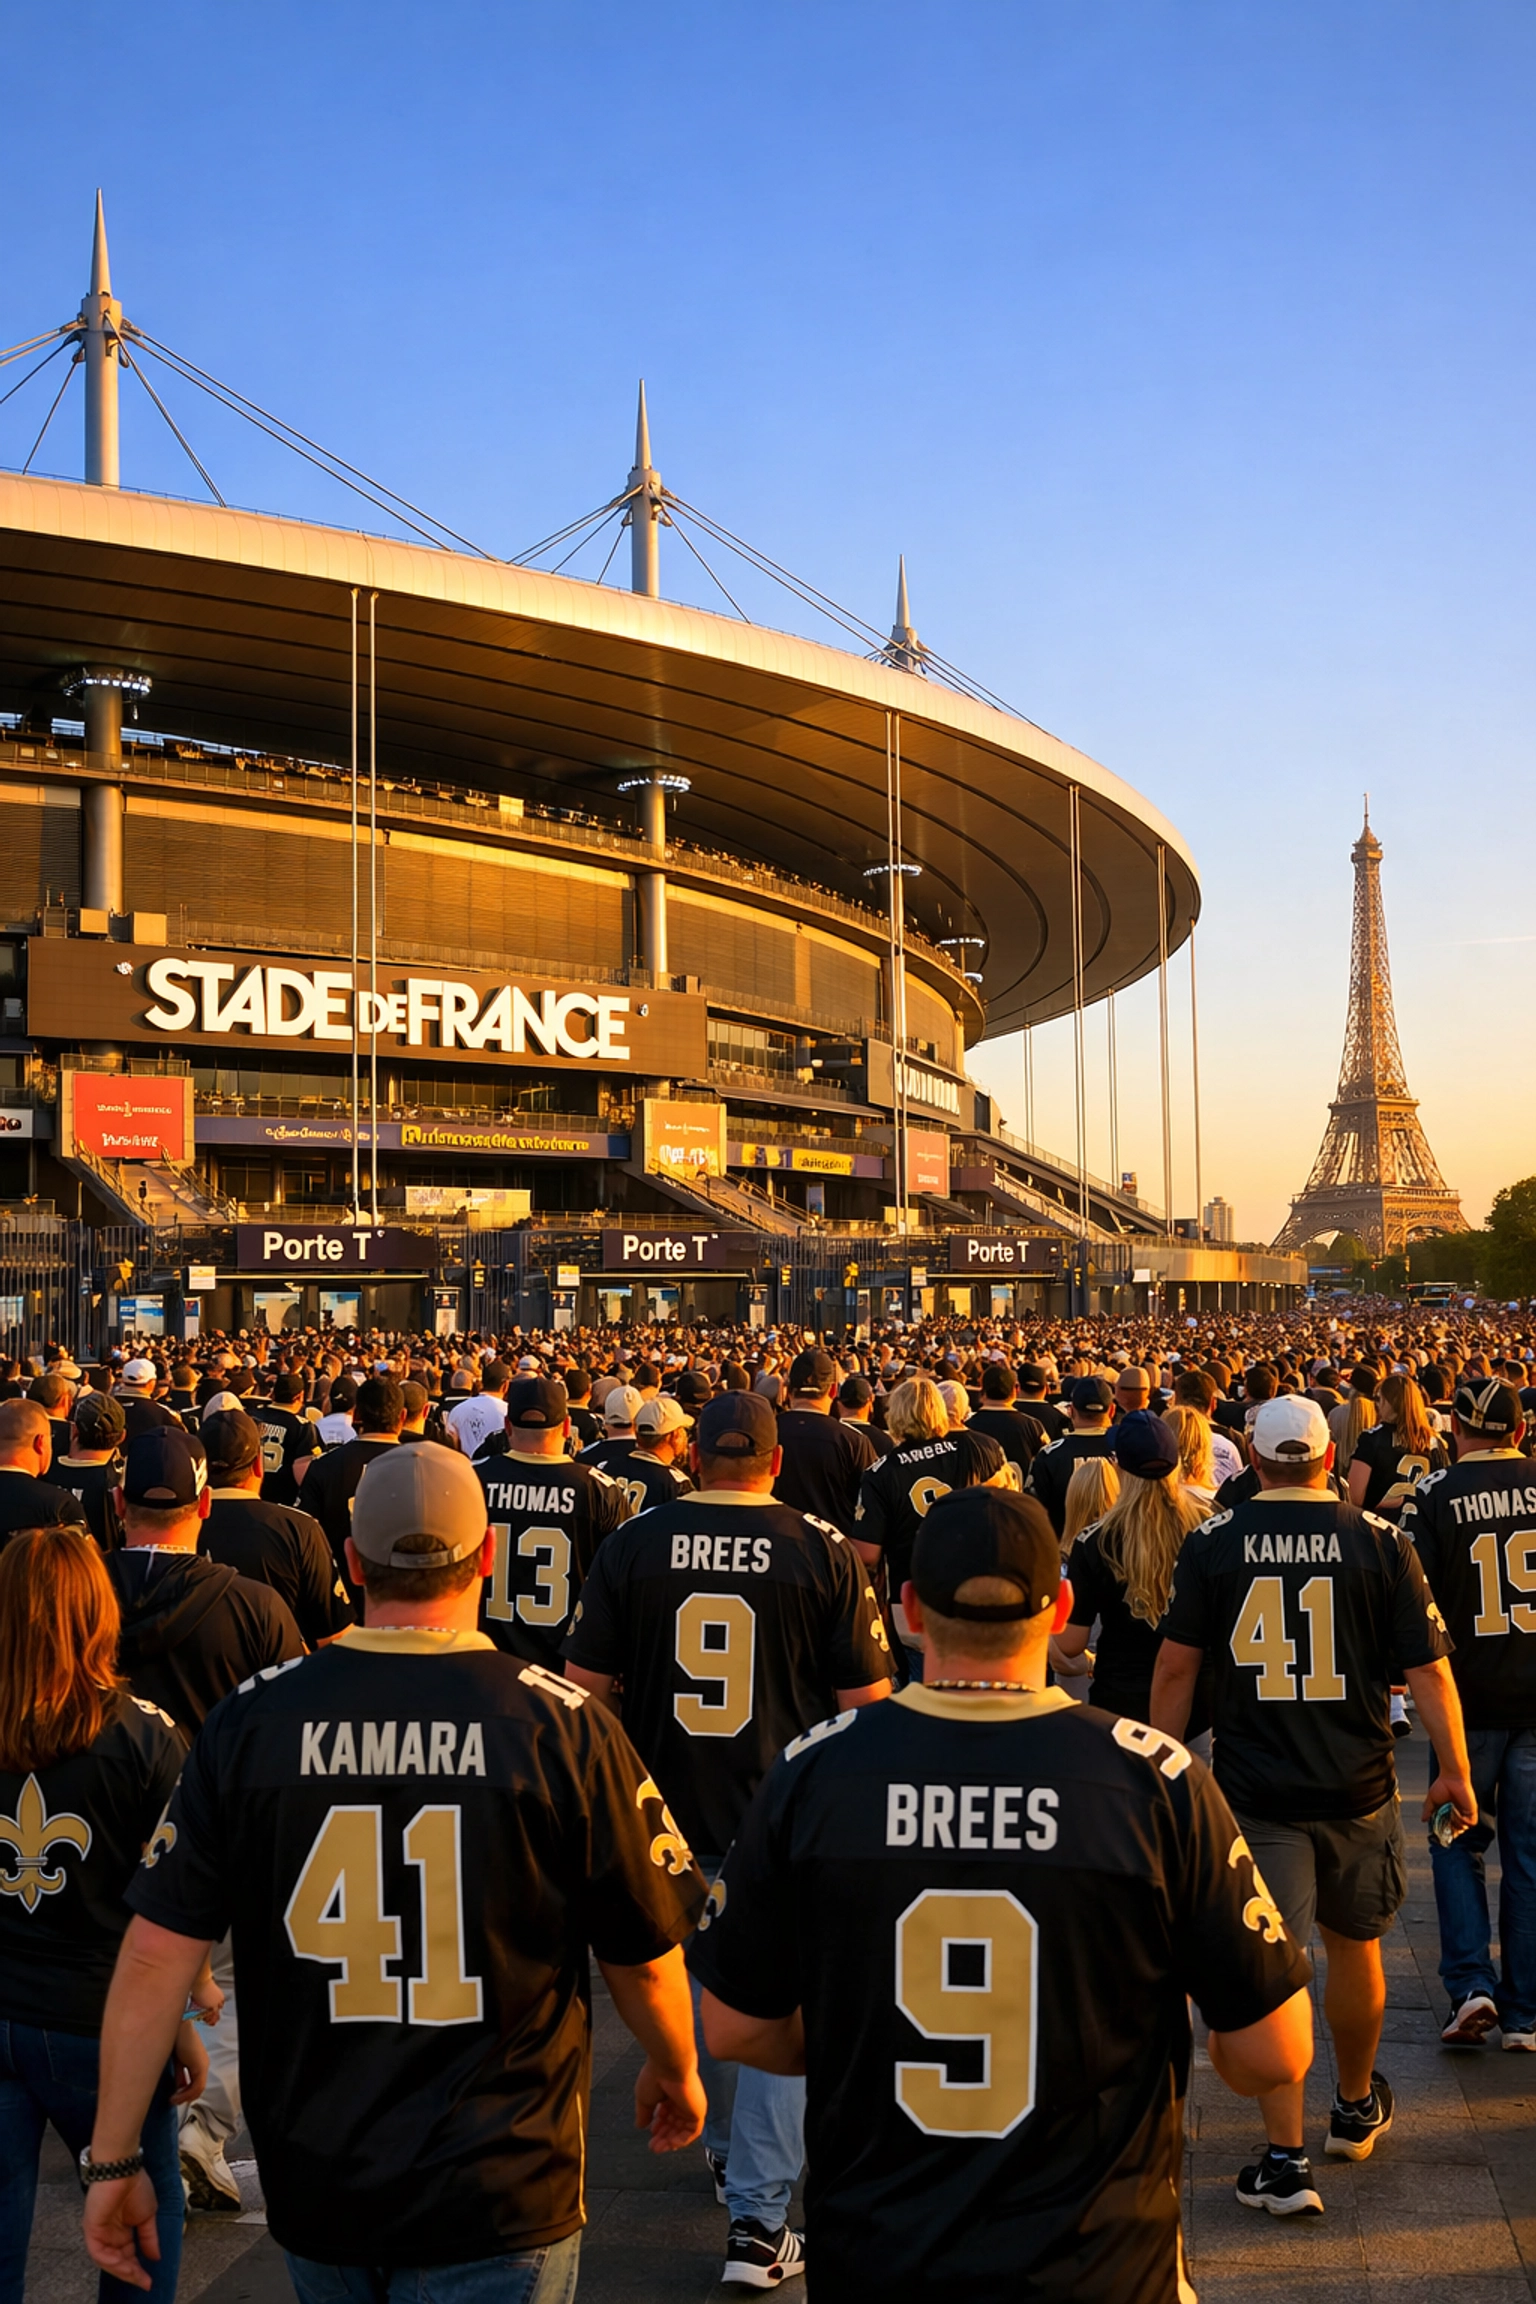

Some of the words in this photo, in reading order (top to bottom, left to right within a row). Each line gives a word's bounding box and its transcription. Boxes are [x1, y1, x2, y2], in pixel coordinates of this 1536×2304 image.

[144, 957, 354, 1041] STADE
[358, 988, 407, 1034] DE
[407, 977, 631, 1060] FRANCE
[262, 1231, 344, 1262] Porte
[622, 1234, 687, 1262] Porte
[967, 1239, 1015, 1263] Porte
[1017, 1240, 1030, 1263] T
[486, 1482, 576, 1514] THOMAS
[1449, 1486, 1536, 1525] THOMAS
[485, 1522, 572, 1628] 13
[670, 1534, 773, 1574] BREES
[1243, 1532, 1343, 1563] KAMARA
[673, 1592, 756, 1738] 9
[1229, 1576, 1347, 1701] 41
[300, 1720, 487, 1777] KAMARA
[886, 1783, 1060, 1851] BREES
[284, 1804, 484, 2027] 41
[895, 1888, 1039, 2139] 9
